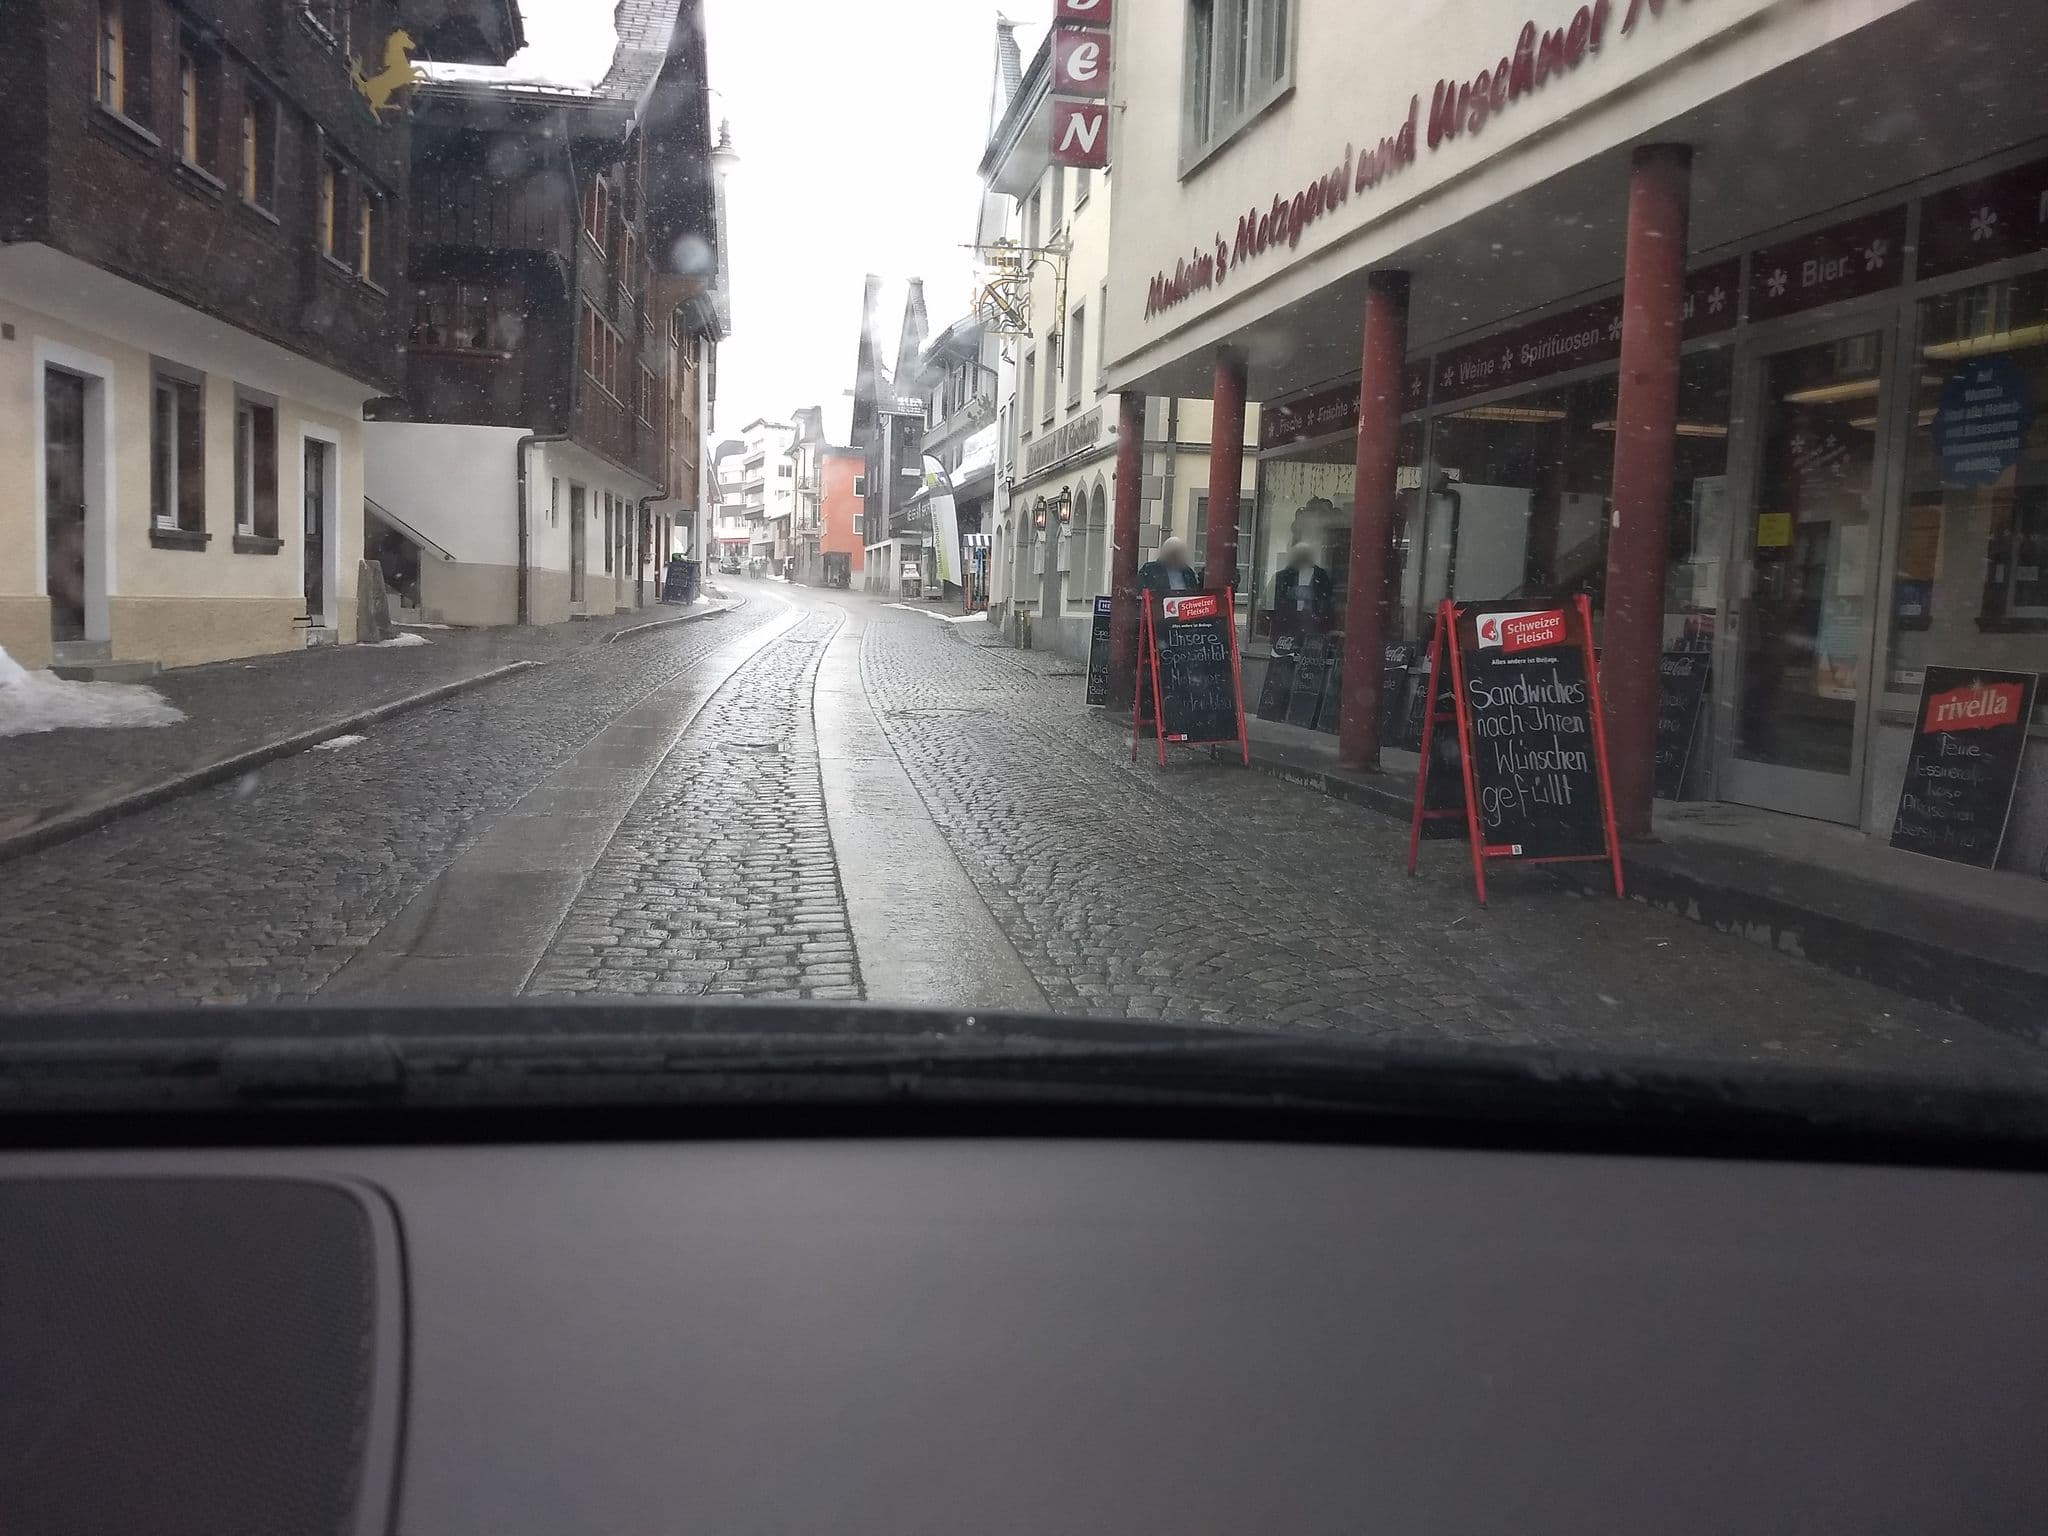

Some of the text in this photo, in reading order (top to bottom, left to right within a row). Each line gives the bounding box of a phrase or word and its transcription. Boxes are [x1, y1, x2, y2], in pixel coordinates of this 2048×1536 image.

[1230, 142, 1353, 269] Metzgerei
[1355, 93, 1418, 194] und
[1801, 256, 1849, 288] Bier
[1459, 328, 1600, 382] Weine Spirituosen
[1181, 599, 1214, 611] Schweizer
[1187, 606, 1210, 616] Fleisch
[1168, 629, 1220, 647] Unsere
[1507, 615, 1560, 635] Schweizer
[1516, 629, 1554, 645] Fleisch
[1469, 668, 1585, 709] Sandwiches
[1477, 705, 1524, 737] nach
[1936, 689, 2008, 722] rivella
[1495, 734, 1587, 774] Wünschen
[1482, 773, 1572, 827] gefüllt
